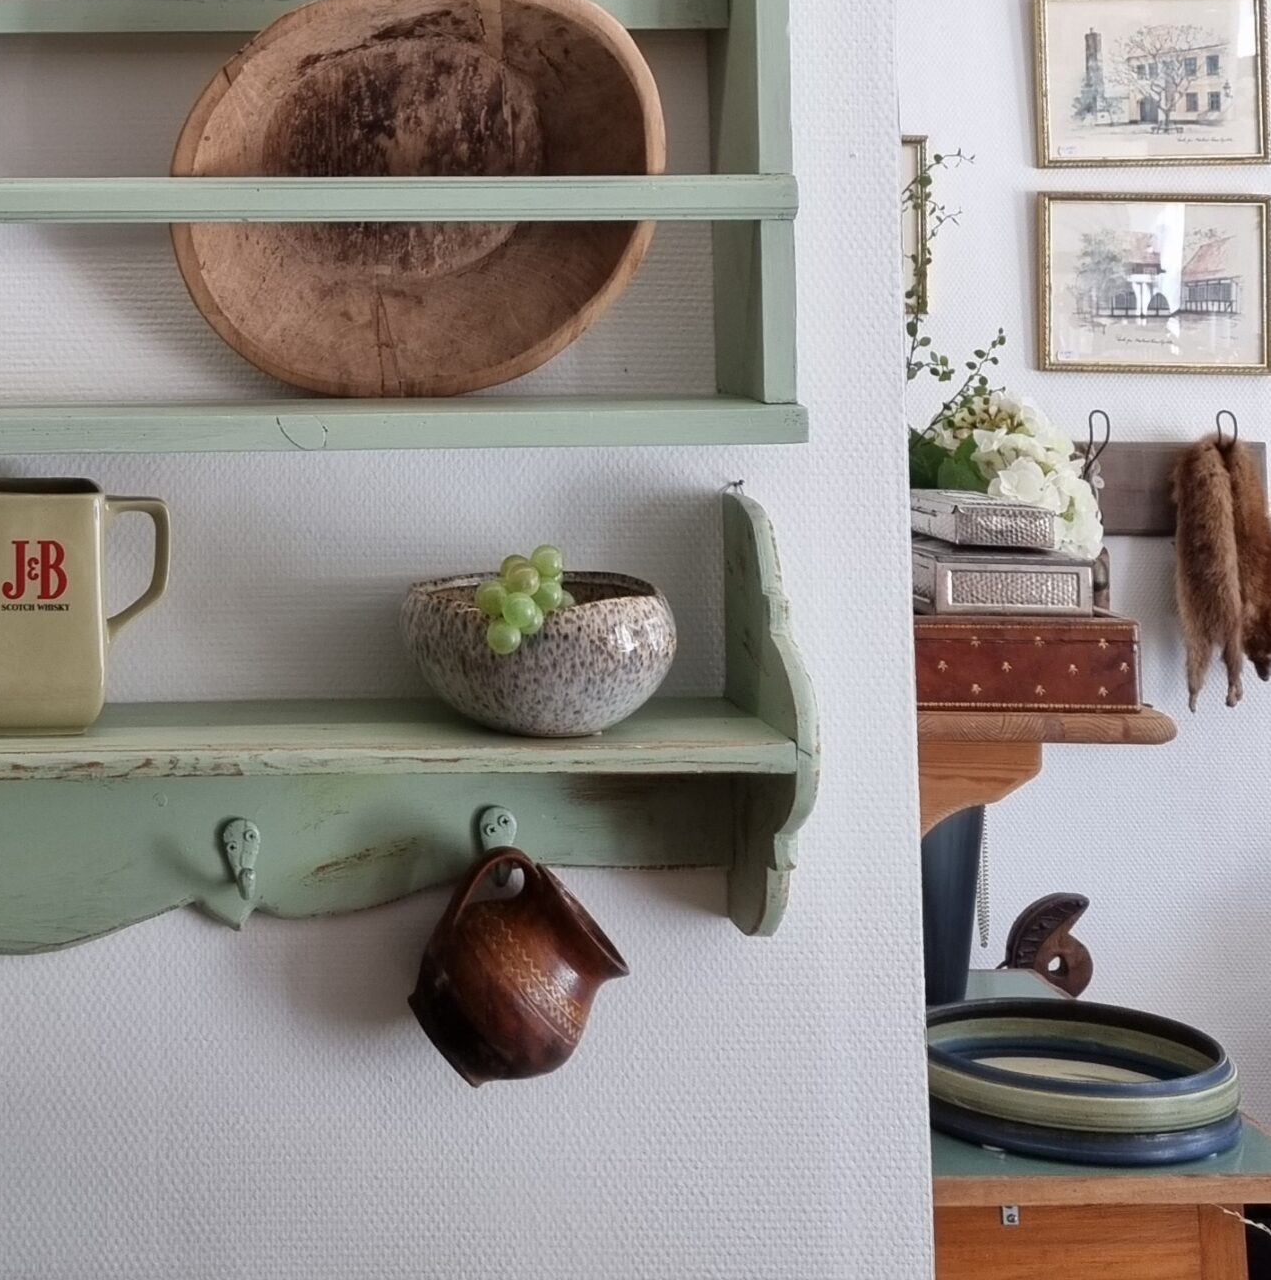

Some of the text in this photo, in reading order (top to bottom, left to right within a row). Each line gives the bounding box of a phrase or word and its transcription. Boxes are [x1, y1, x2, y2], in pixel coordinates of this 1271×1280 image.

[2, 540, 68, 600] J&B
[1, 604, 70, 612] SCOTCH WHISKY
